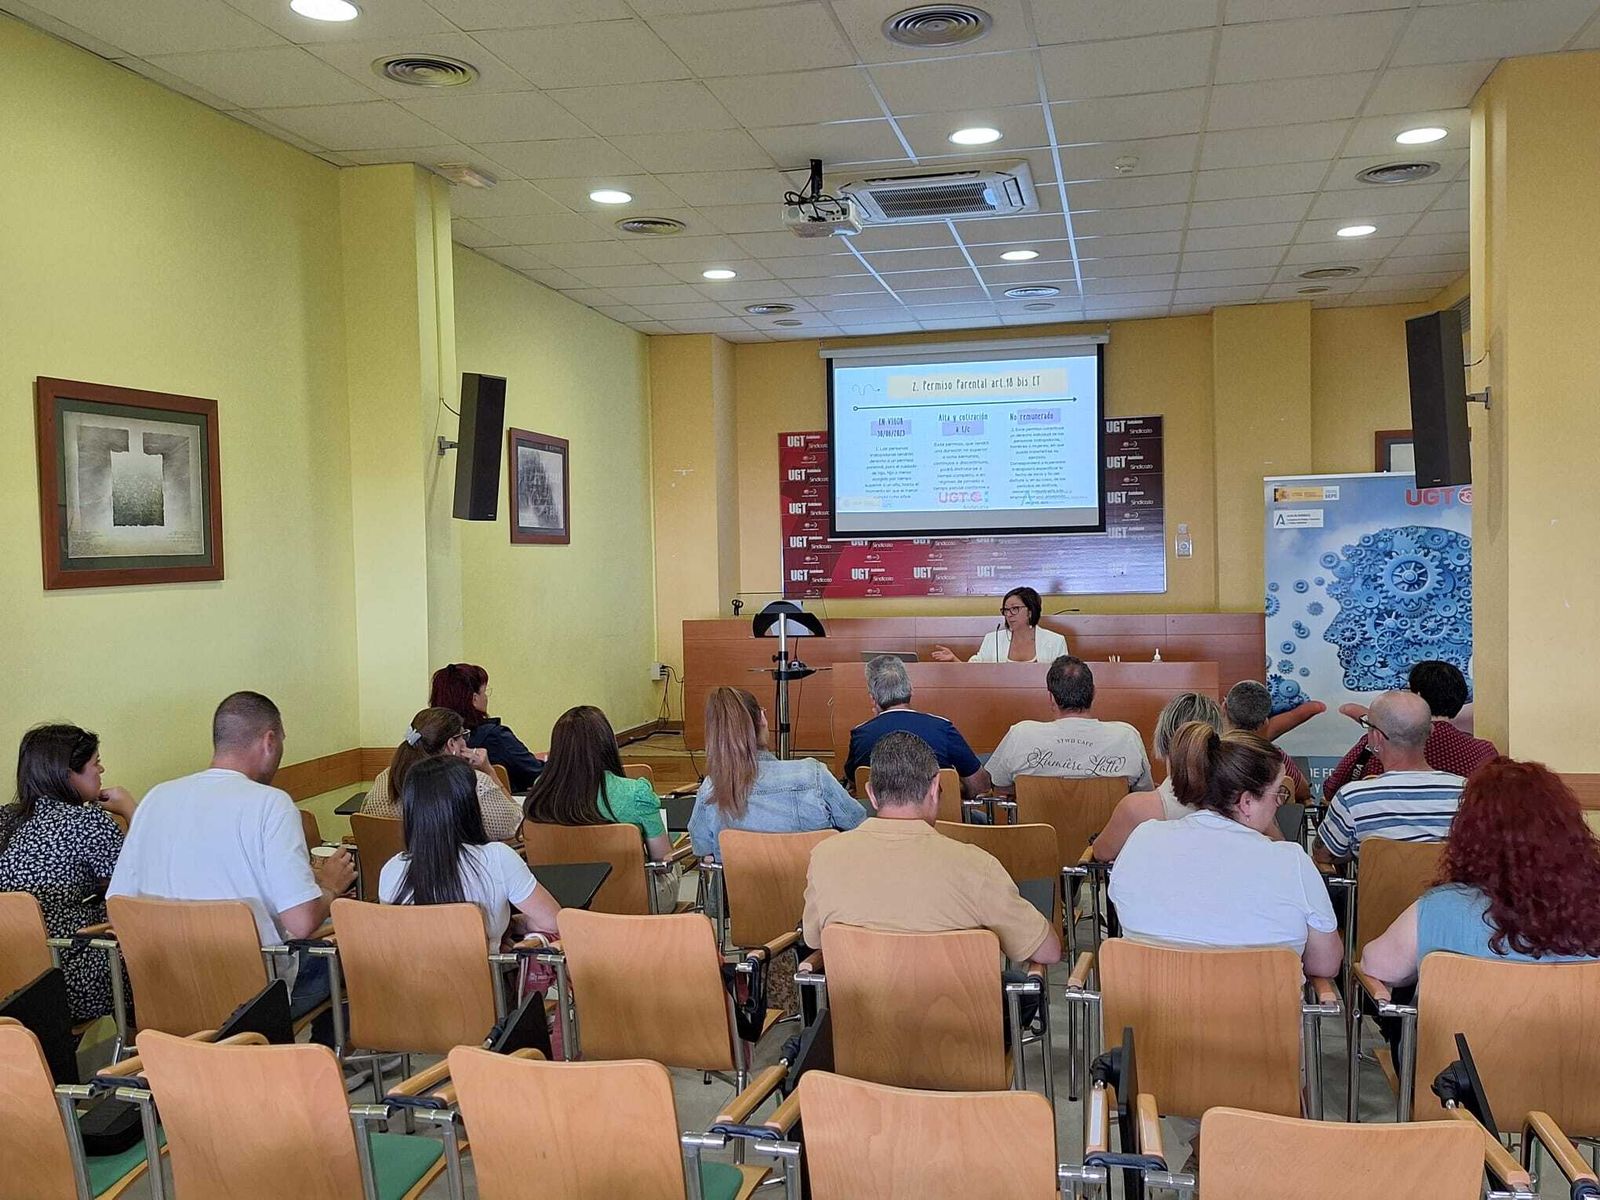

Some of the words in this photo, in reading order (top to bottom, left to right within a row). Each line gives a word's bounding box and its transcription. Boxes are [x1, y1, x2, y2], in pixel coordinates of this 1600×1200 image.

[922, 380, 953, 391] Permiso
[956, 378, 988, 390] Parental
[1017, 376, 1028, 387] bis
[1032, 375, 1041, 387] ET
[938, 413, 950, 422] Alta
[1009, 412, 1017, 421] No
[1019, 411, 1054, 420] remunerado
[1106, 420, 1126, 433] UGT
[787, 435, 805, 447] UGT
[1106, 456, 1127, 469] UGT
[788, 468, 806, 481] UGT
[1107, 491, 1127, 504] UGT
[1405, 487, 1456, 506] UGT
[789, 502, 807, 514] UGT
[790, 536, 808, 548] UGT
[790, 569, 808, 581] UGT
[851, 568, 870, 580] UGT
[913, 567, 932, 579] UGT
[976, 565, 996, 577] UGT
